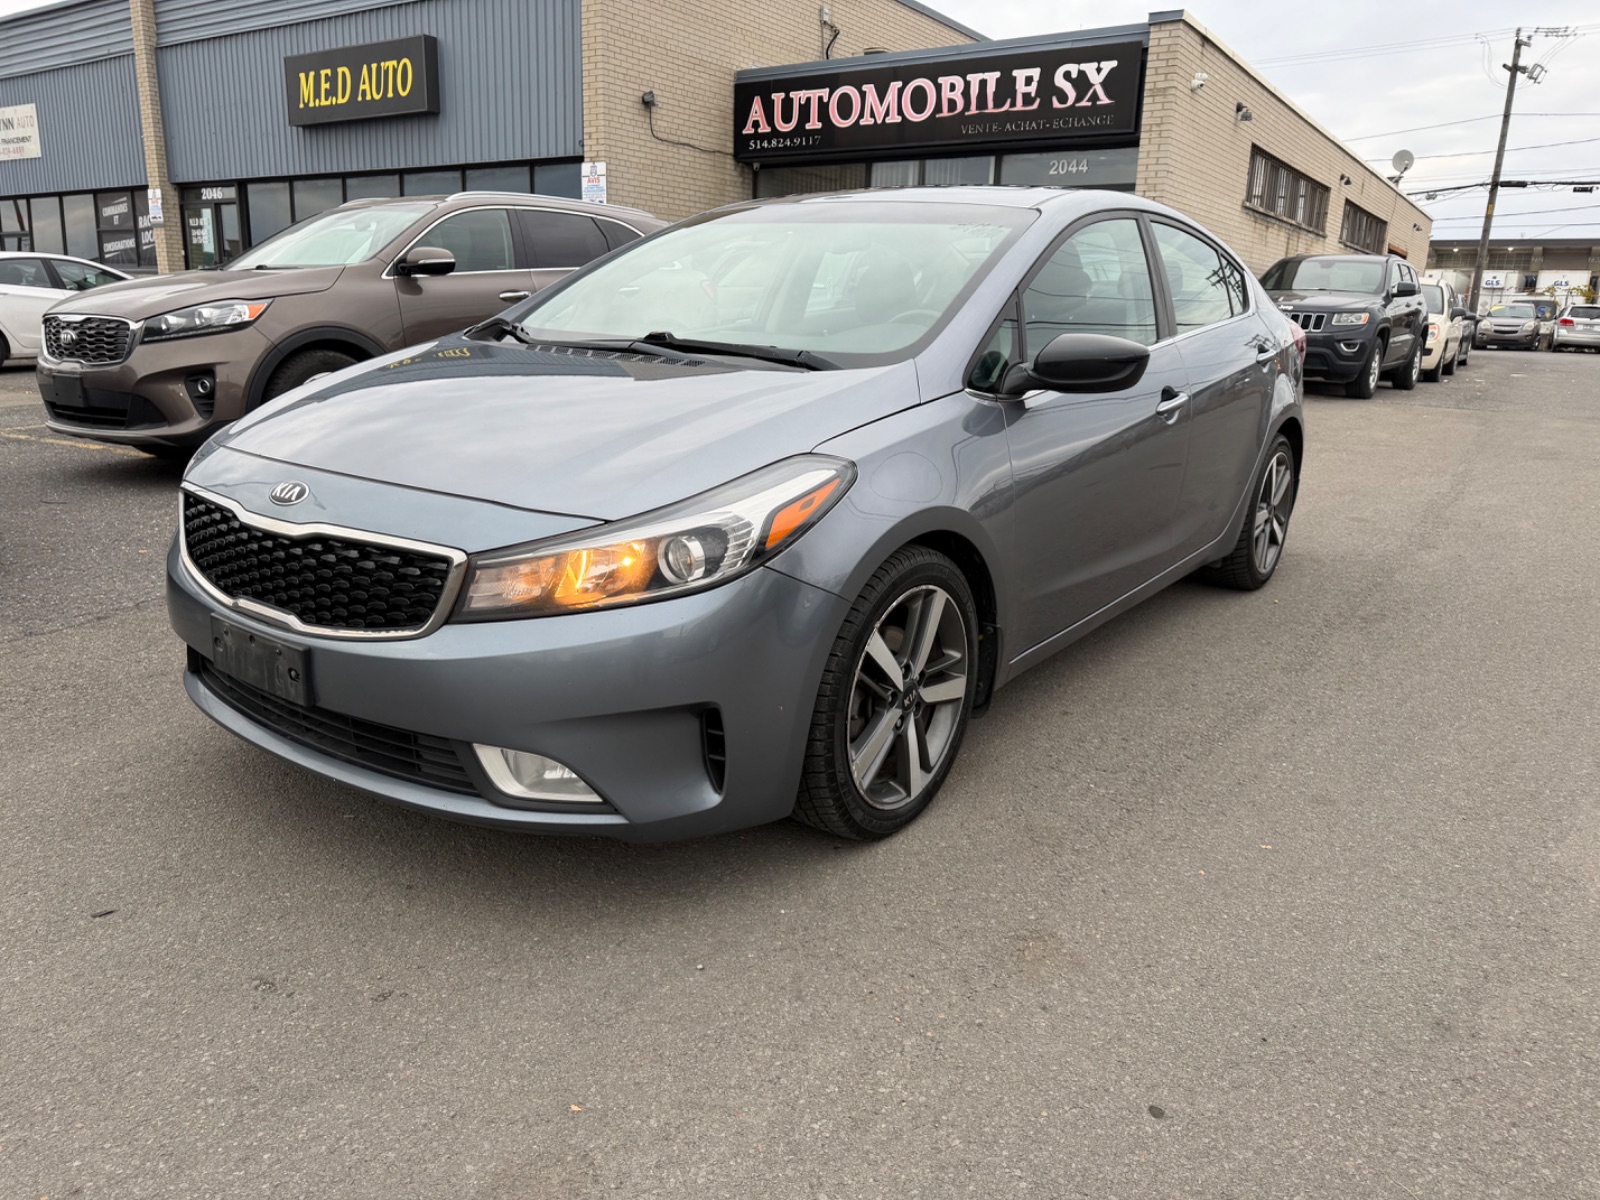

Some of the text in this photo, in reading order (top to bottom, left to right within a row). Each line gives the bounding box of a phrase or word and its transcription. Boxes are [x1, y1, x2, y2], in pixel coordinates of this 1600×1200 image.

[298, 57, 413, 109] M.E.D AUTO
[742, 59, 1118, 135] AUTOMOBILE SX
[17, 115, 35, 129] AUTO
[749, 135, 821, 150] 514.824.9117
[1048, 158, 1089, 175] 2044
[201, 187, 223, 200] 2046
[102, 203, 128, 217] COMMANDES
[113, 215, 119, 225] ET
[103, 239, 136, 252] CONSIGNATIONS
[1485, 279, 1500, 287] GLS
[271, 482, 302, 501] KIA
[903, 689, 917, 707] KIA
